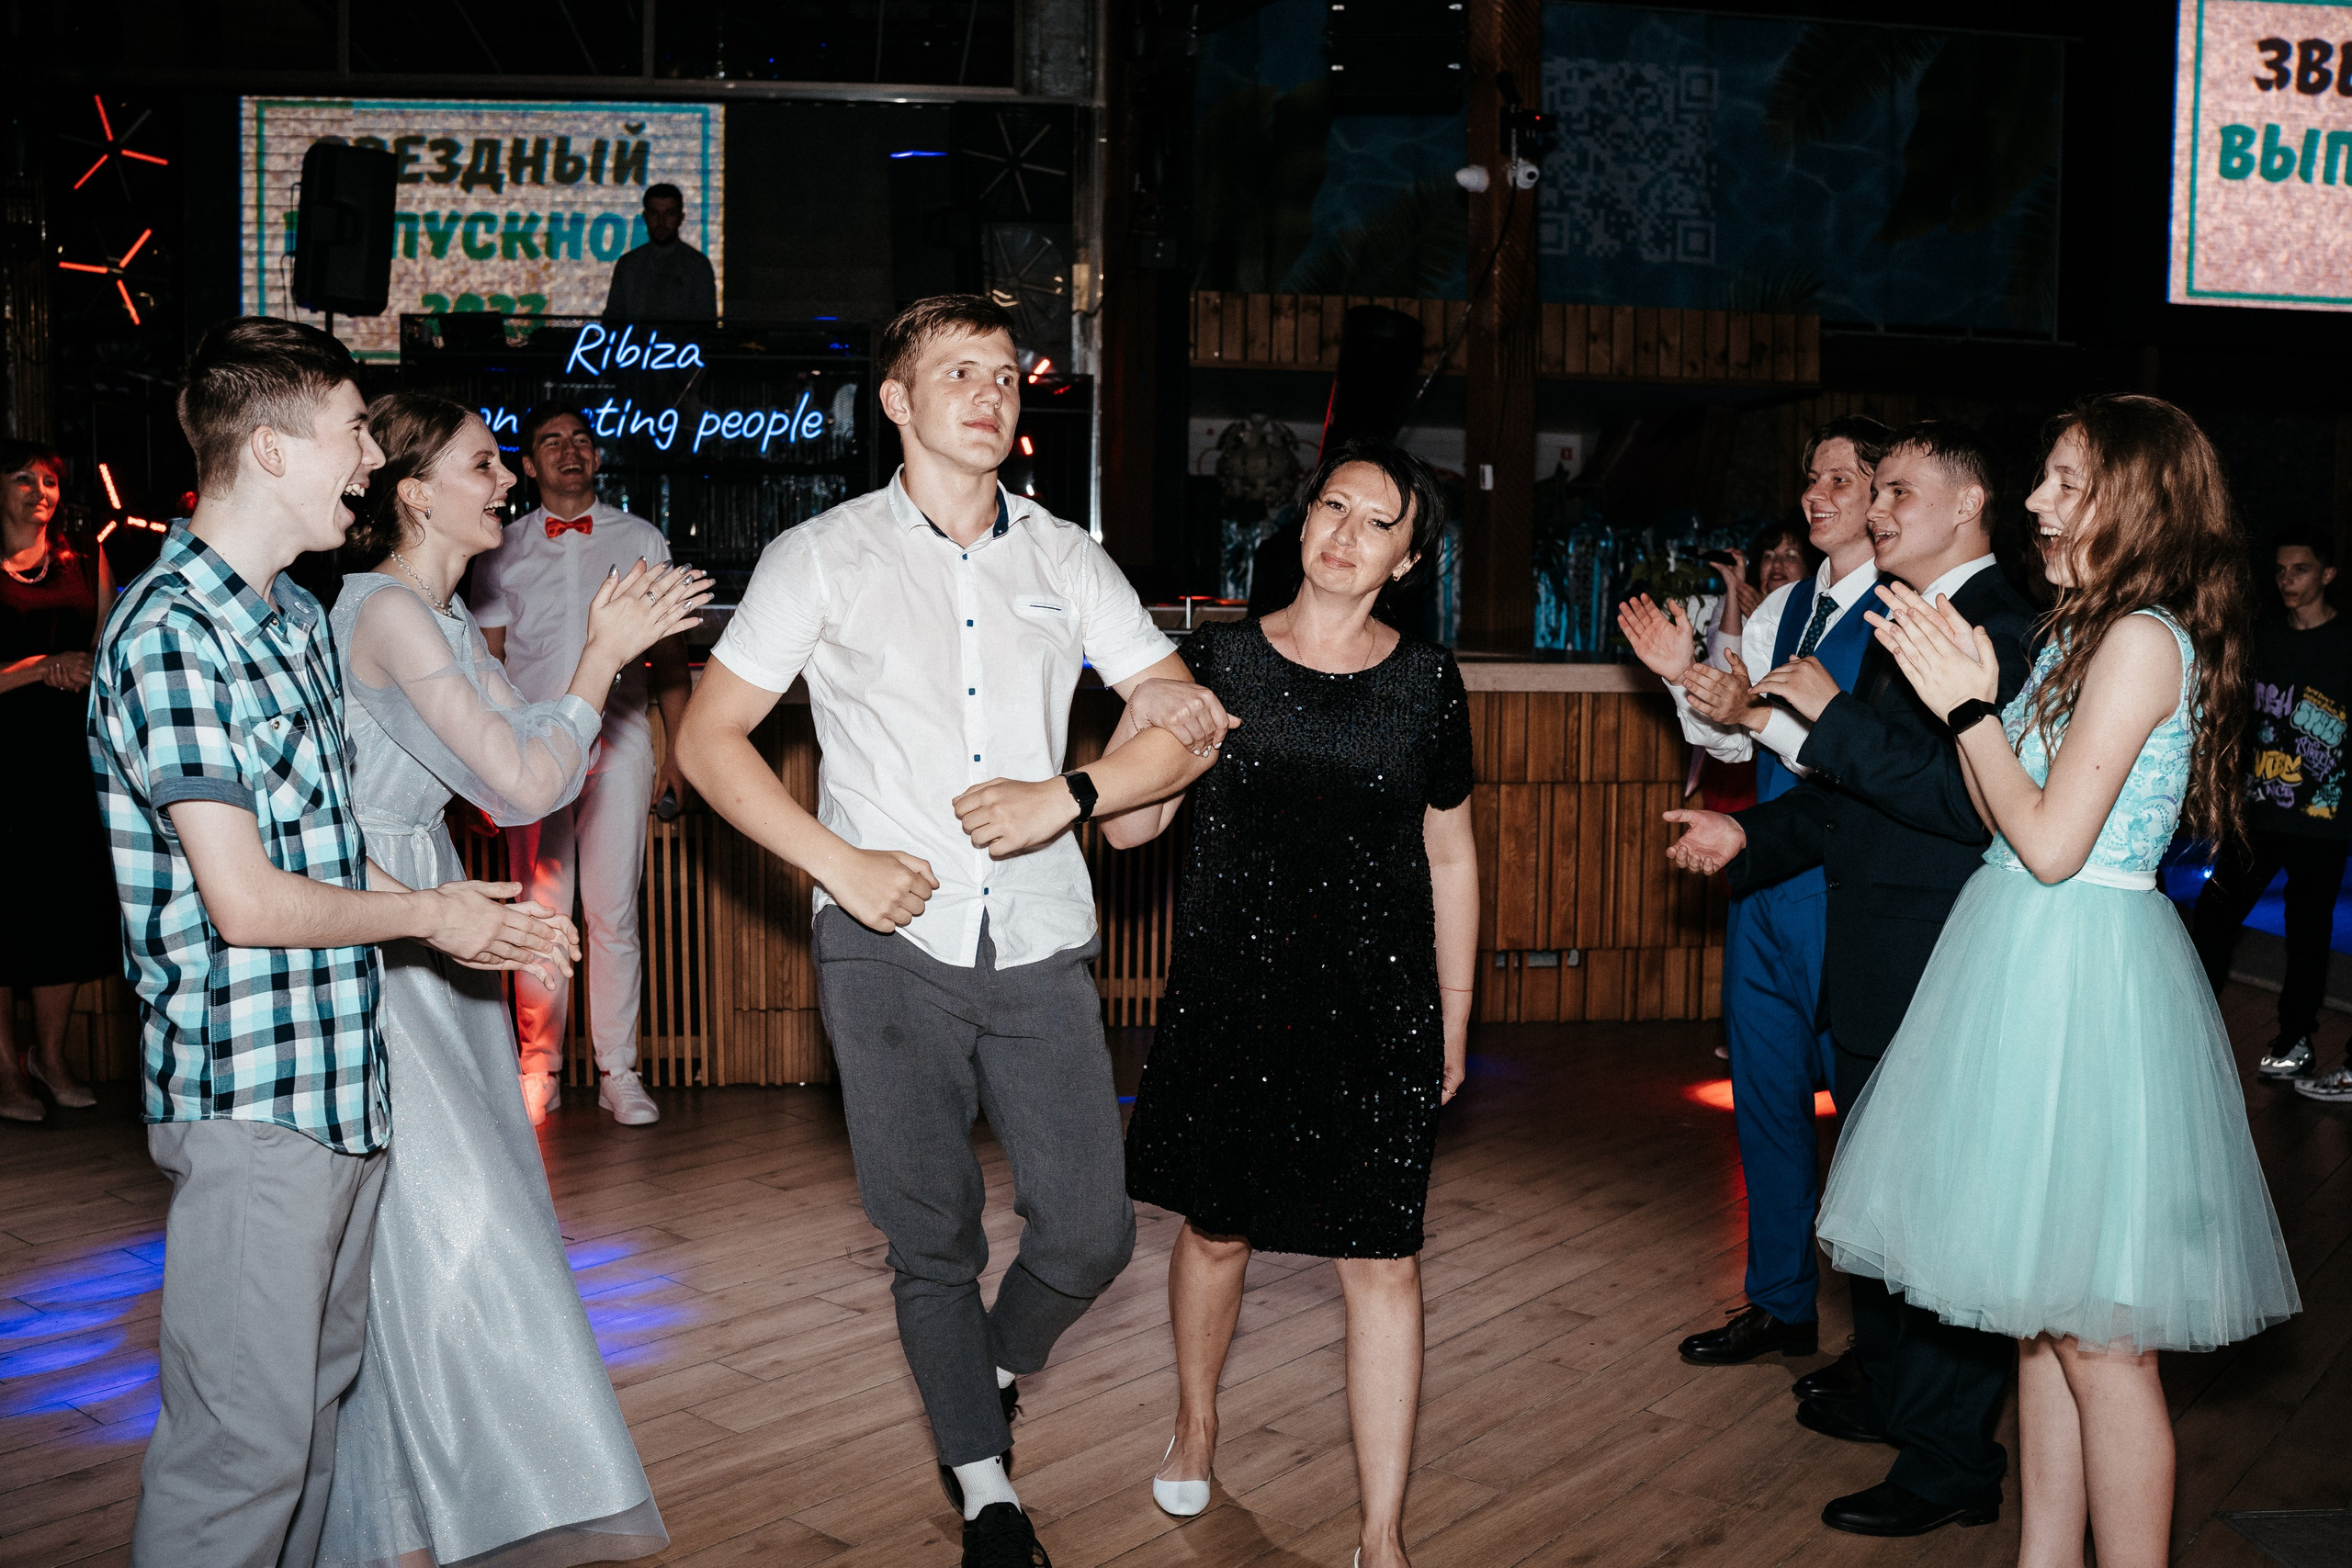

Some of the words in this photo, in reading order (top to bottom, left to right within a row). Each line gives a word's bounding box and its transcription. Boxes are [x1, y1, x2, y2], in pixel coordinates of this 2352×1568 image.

[317, 121, 650, 194] ЕЗДНЫЙ
[2219, 123, 2352, 186] ВЫП
[284, 209, 650, 262] ПУСКНО
[565, 322, 706, 377] Ribiza
[691, 390, 824, 454] people
